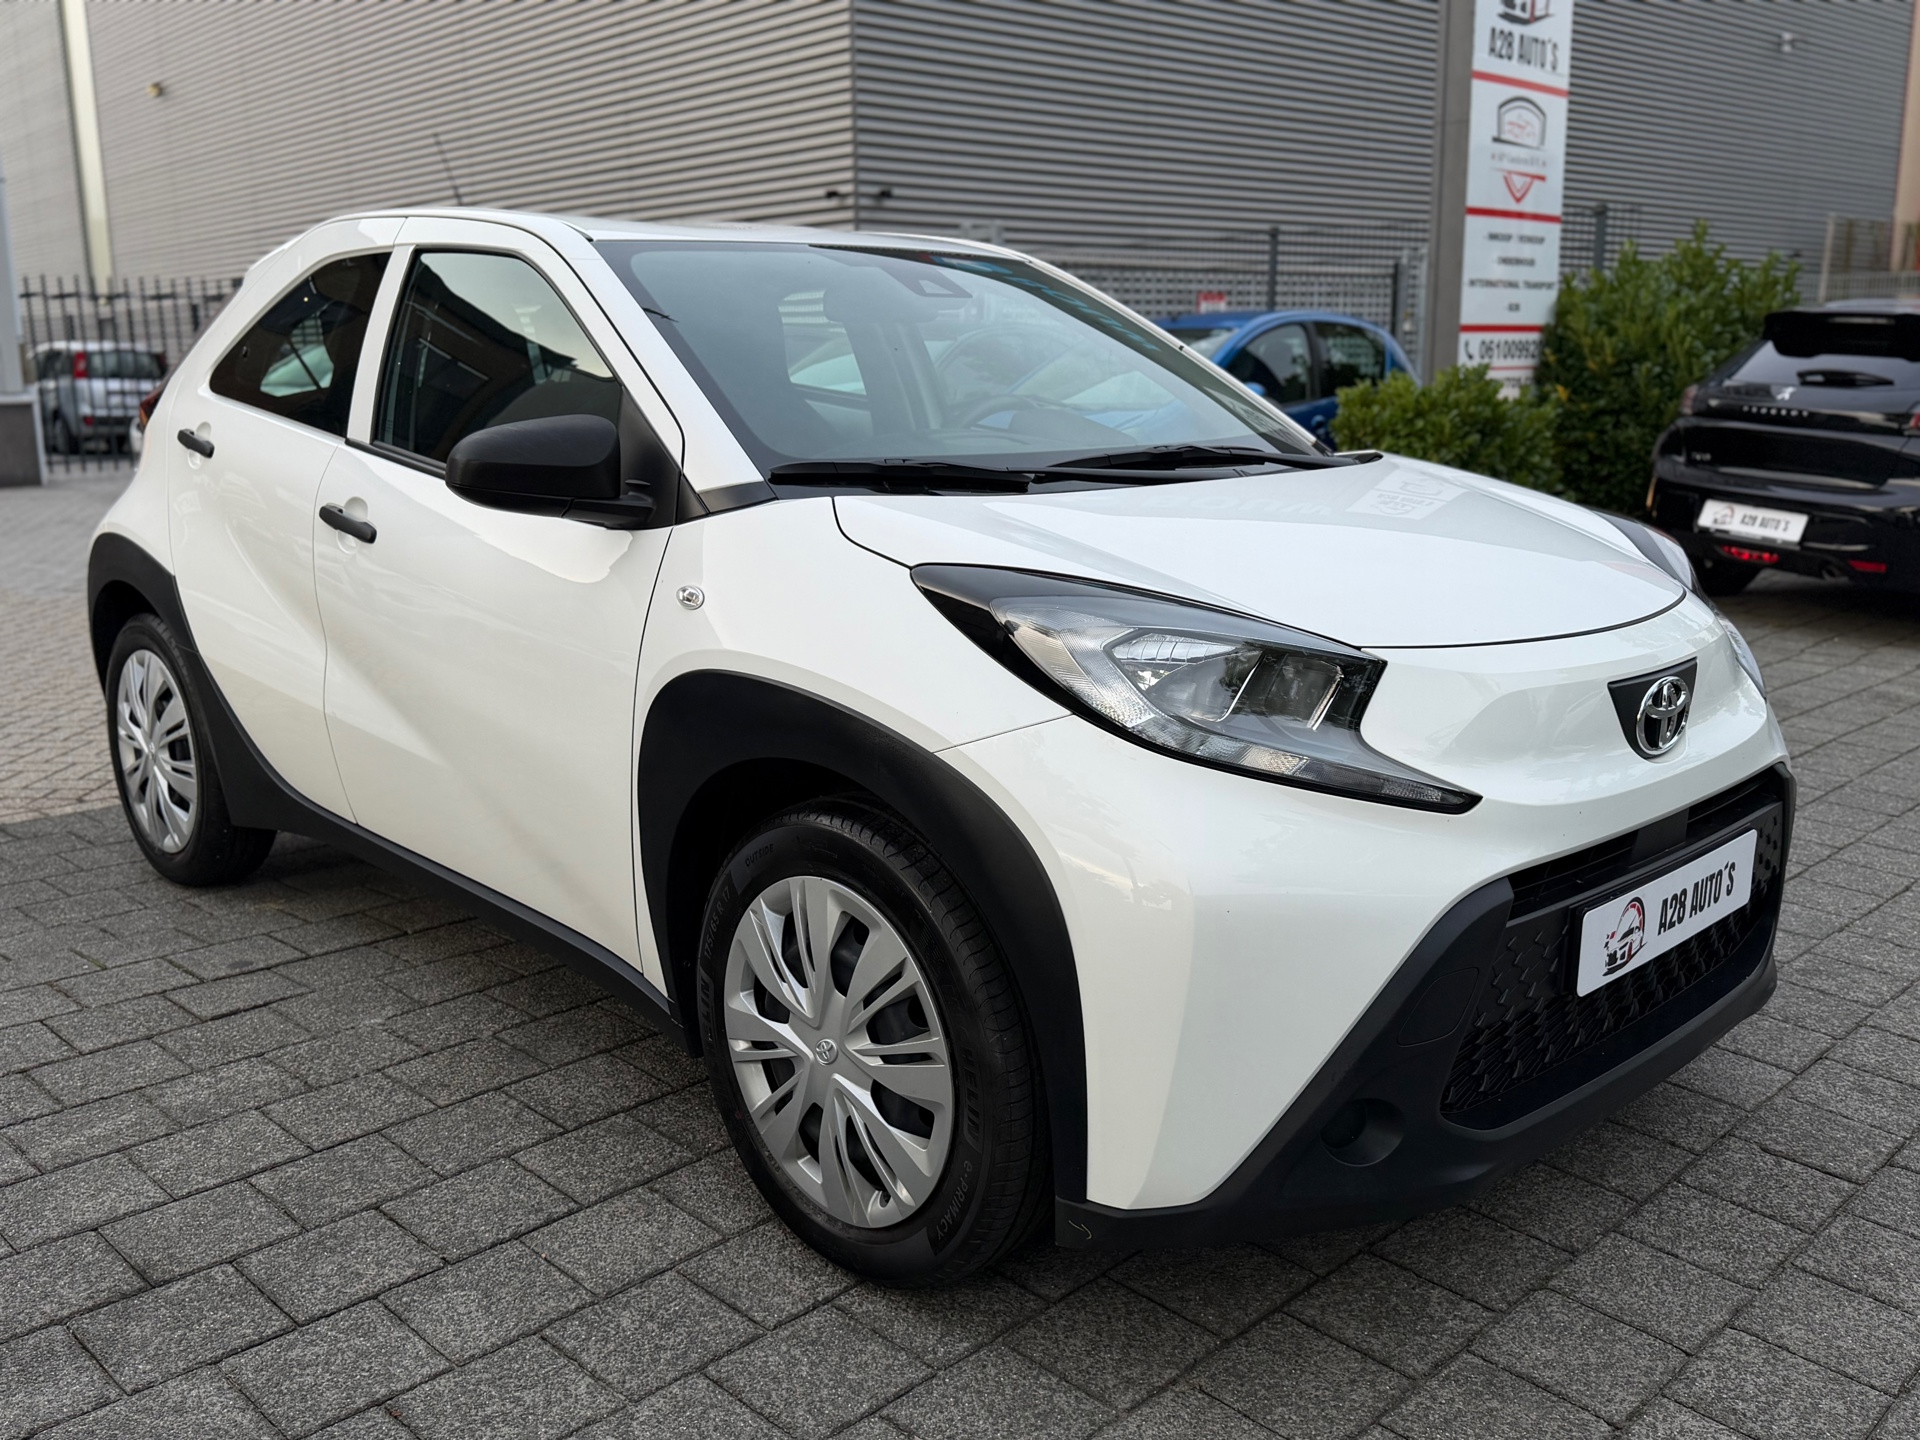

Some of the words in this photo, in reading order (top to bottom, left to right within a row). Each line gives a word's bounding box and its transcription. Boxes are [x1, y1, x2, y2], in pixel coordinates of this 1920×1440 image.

[1488, 27, 1514, 61] A28
[744, 842, 774, 868] OUTSIDE
[1657, 887, 1688, 936] A28
